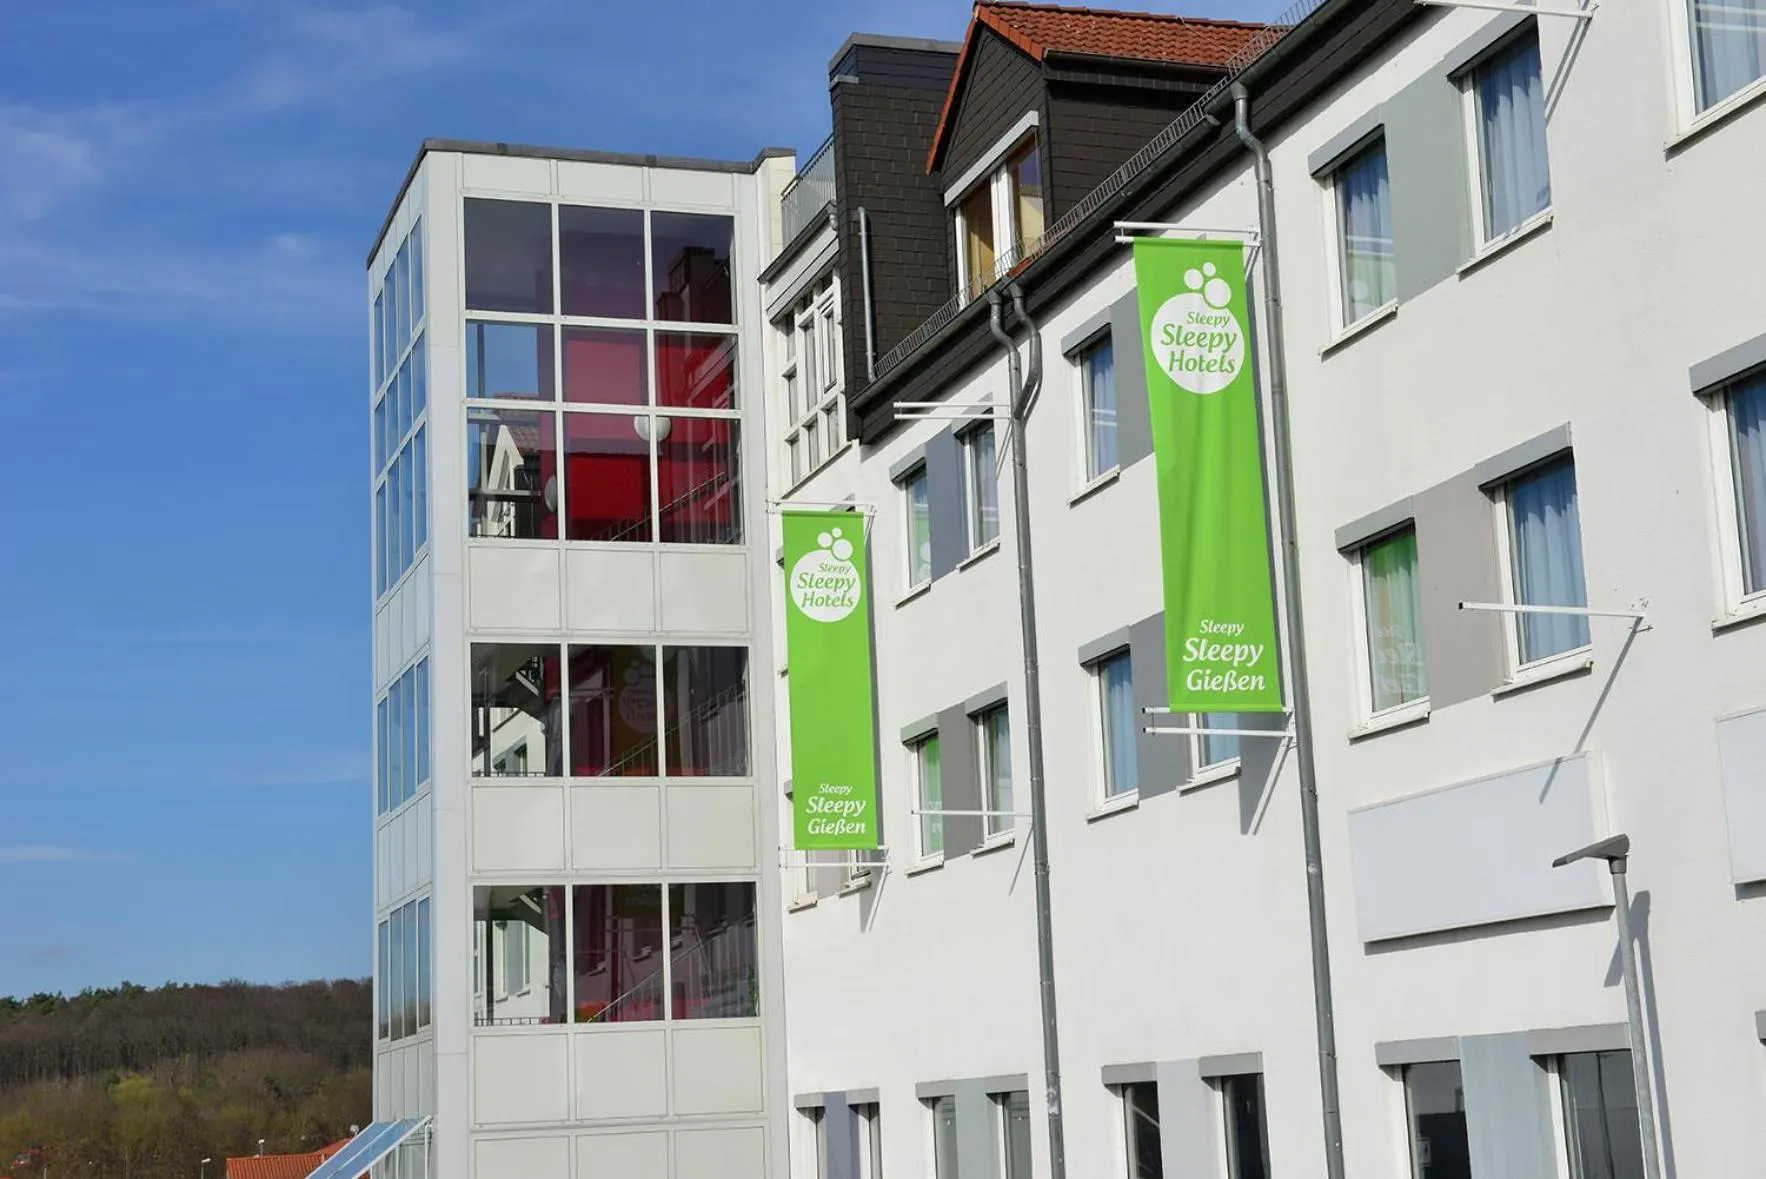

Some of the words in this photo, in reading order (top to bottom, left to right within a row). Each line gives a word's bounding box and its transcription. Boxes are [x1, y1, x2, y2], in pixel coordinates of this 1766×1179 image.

[1187, 311, 1230, 328] Sleepy
[1161, 323, 1238, 353] Sleepy
[1168, 349, 1236, 374] Hotels
[797, 571, 856, 593] Sleepy
[801, 591, 854, 608] Hotels
[1199, 619, 1245, 637] Sleepy
[1182, 637, 1264, 667] Sleepy
[1186, 668, 1266, 693] Gießen
[819, 783, 854, 796] Sleepy
[805, 796, 866, 817] Sleepy
[807, 818, 866, 835] Gießen
